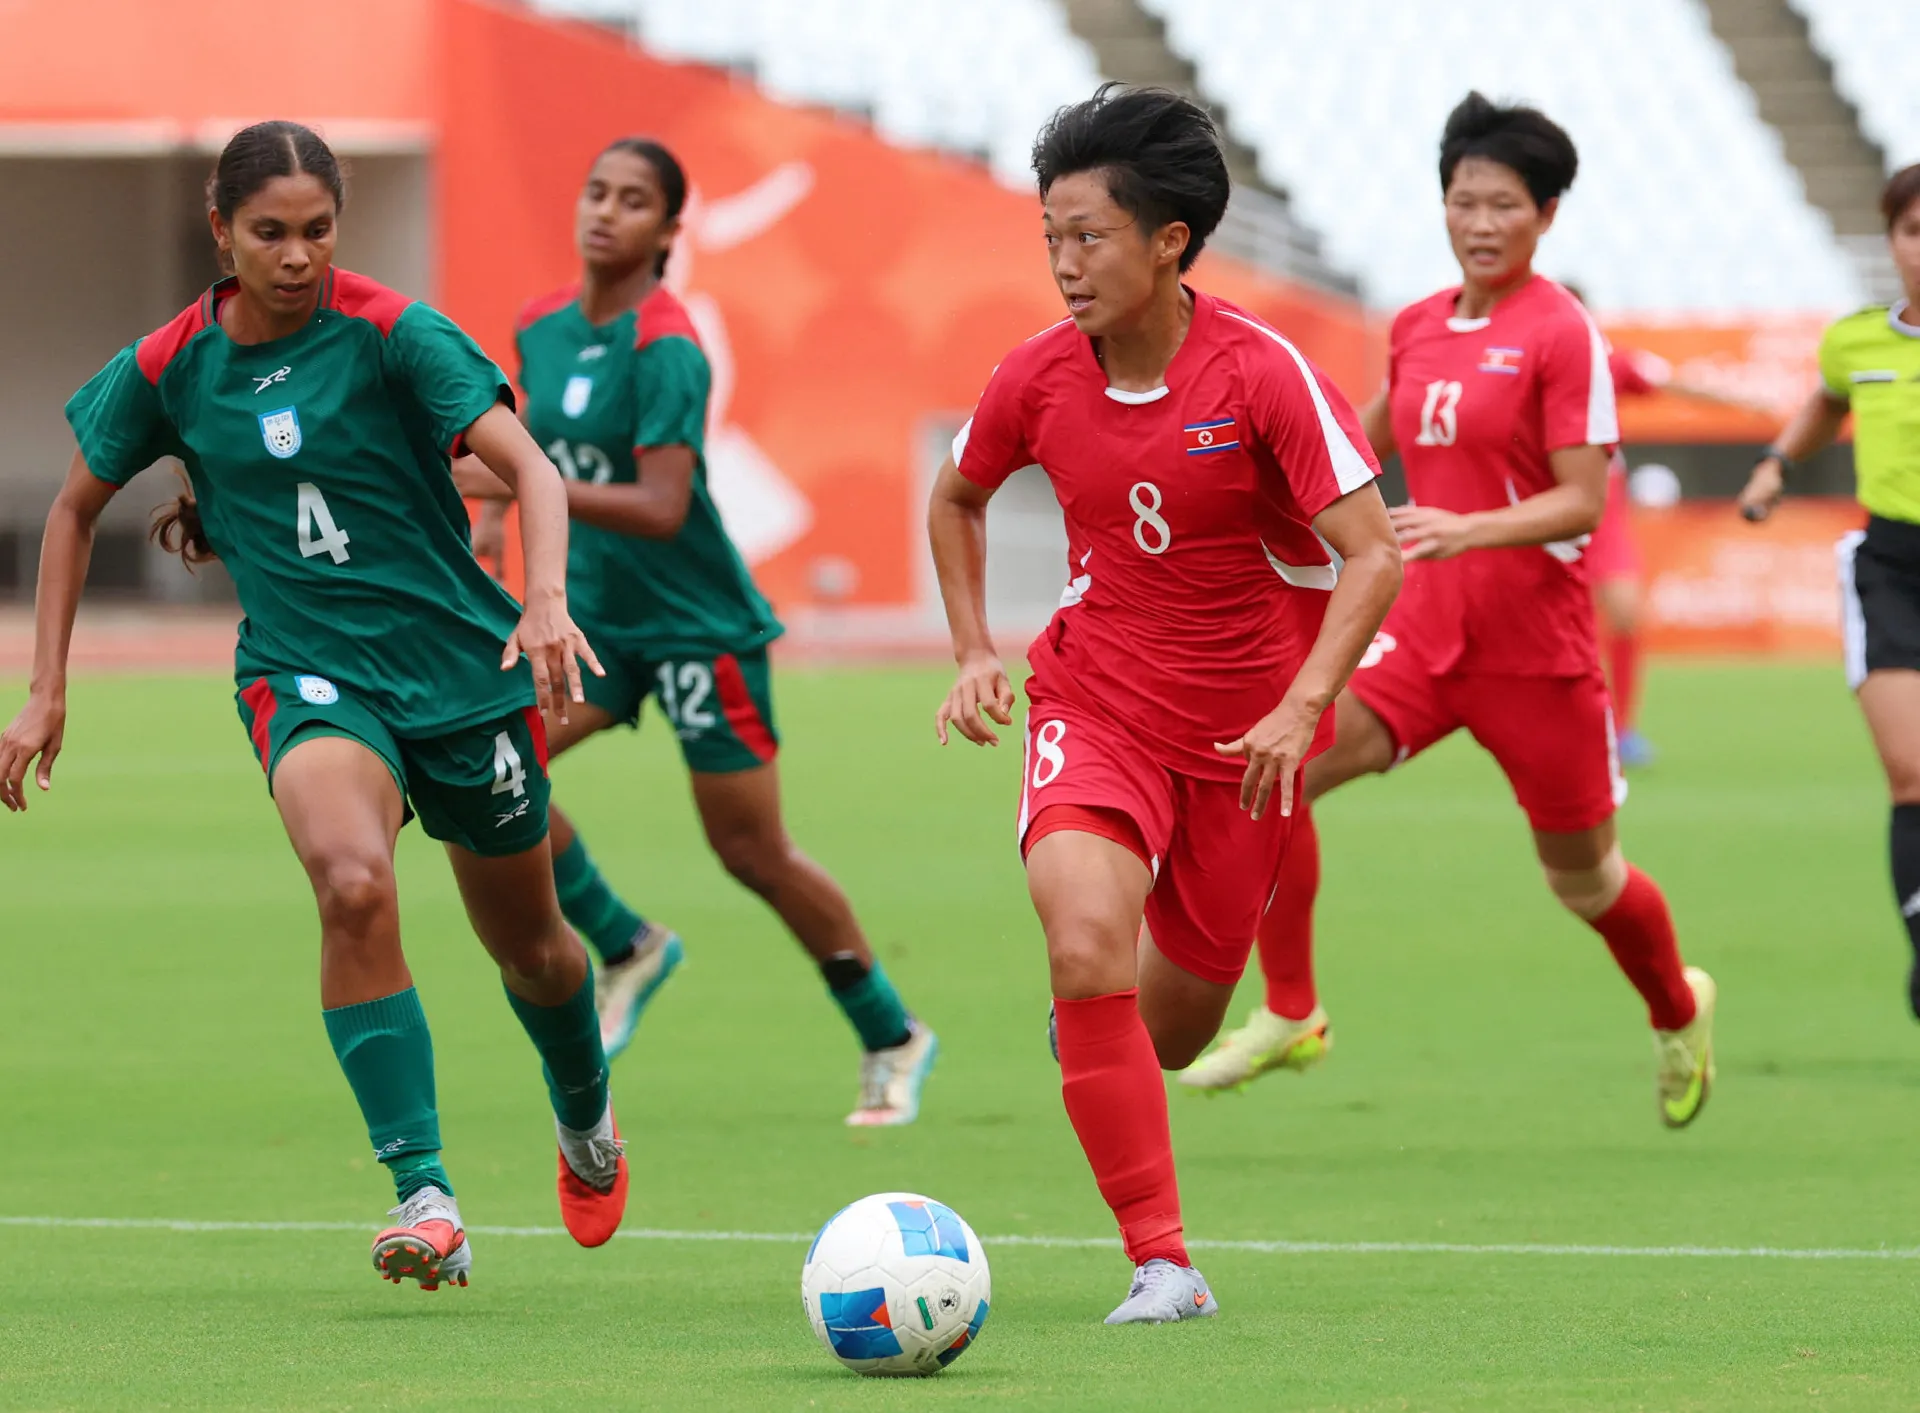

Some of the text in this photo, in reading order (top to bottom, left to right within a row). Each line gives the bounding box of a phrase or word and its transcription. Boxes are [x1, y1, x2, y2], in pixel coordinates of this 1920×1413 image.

[1415, 379, 1463, 446] 13
[297, 482, 350, 565] 4
[1128, 481, 1171, 555] 8
[656, 660, 715, 728] 12
[491, 731, 527, 798] 4
[1032, 719, 1067, 789] 8
